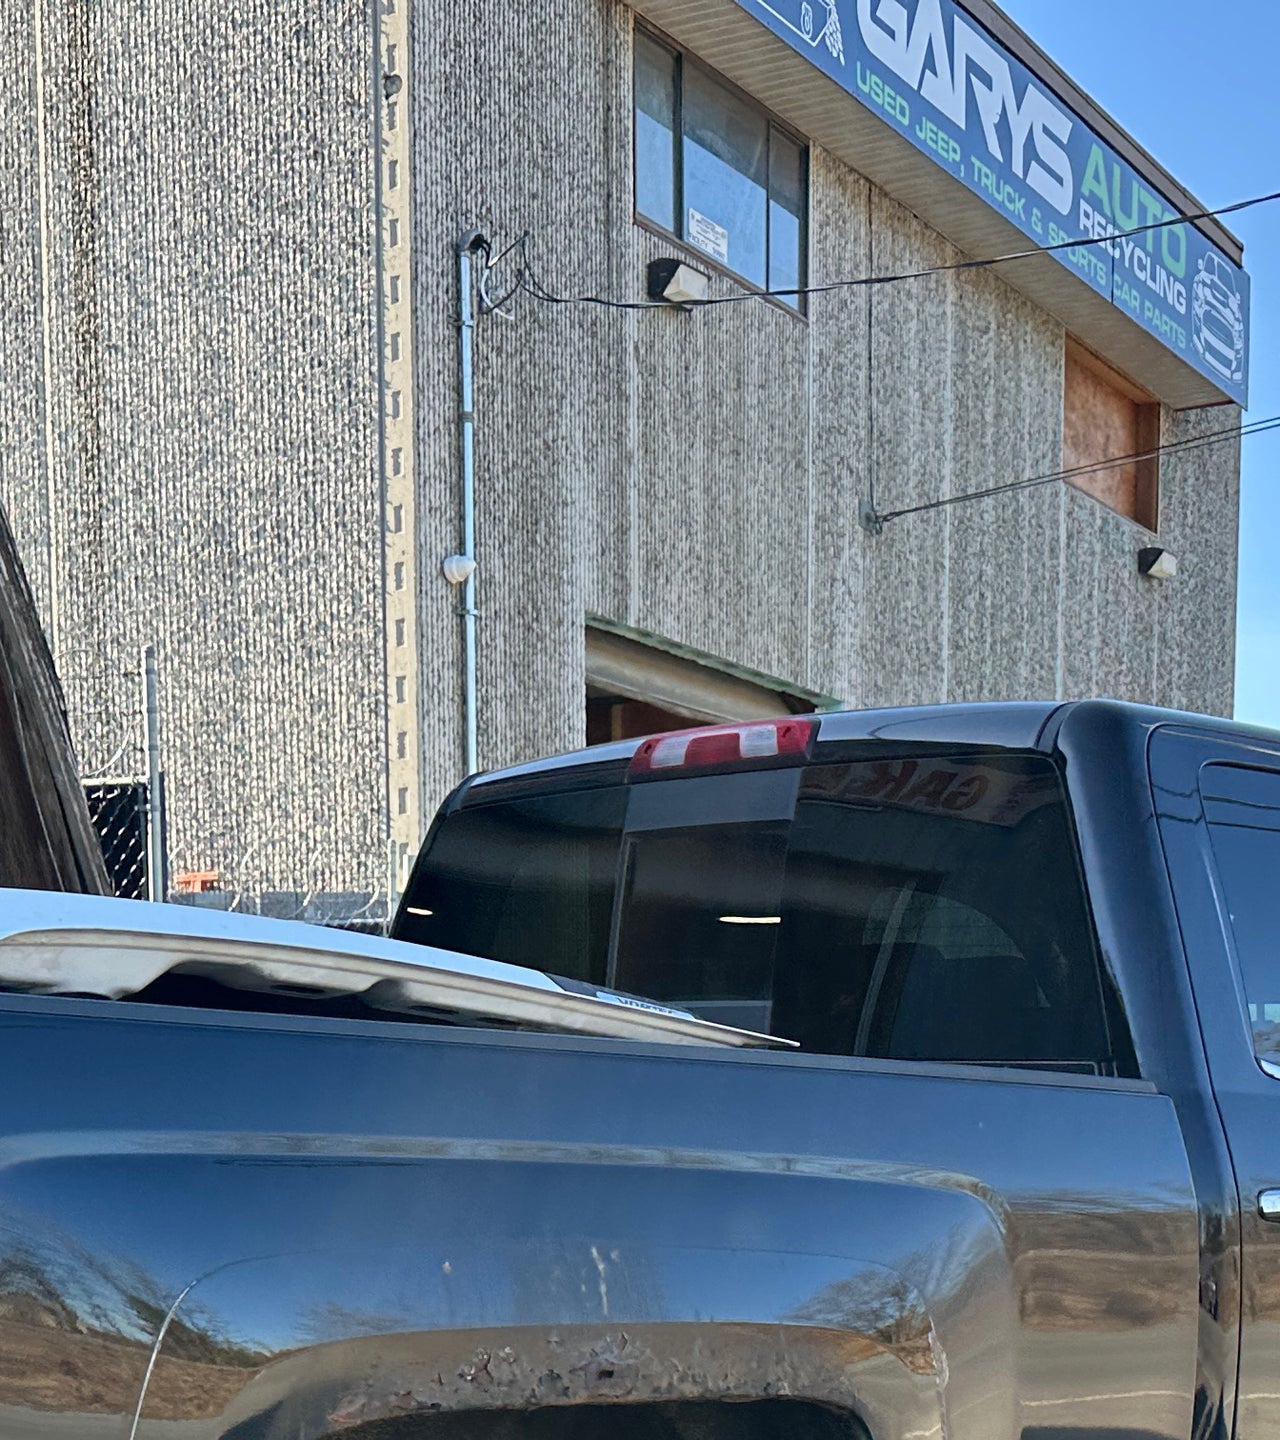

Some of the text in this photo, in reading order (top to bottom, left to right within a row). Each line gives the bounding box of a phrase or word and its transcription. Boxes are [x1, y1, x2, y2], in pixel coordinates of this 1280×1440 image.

[856, 0, 1073, 216] GARYS
[856, 61, 1187, 350] USED JEEP, TRUCK & SPORTS CAR PARTS
[1079, 198, 1187, 315] RECYCLING
[1080, 142, 1187, 279] AUTO
